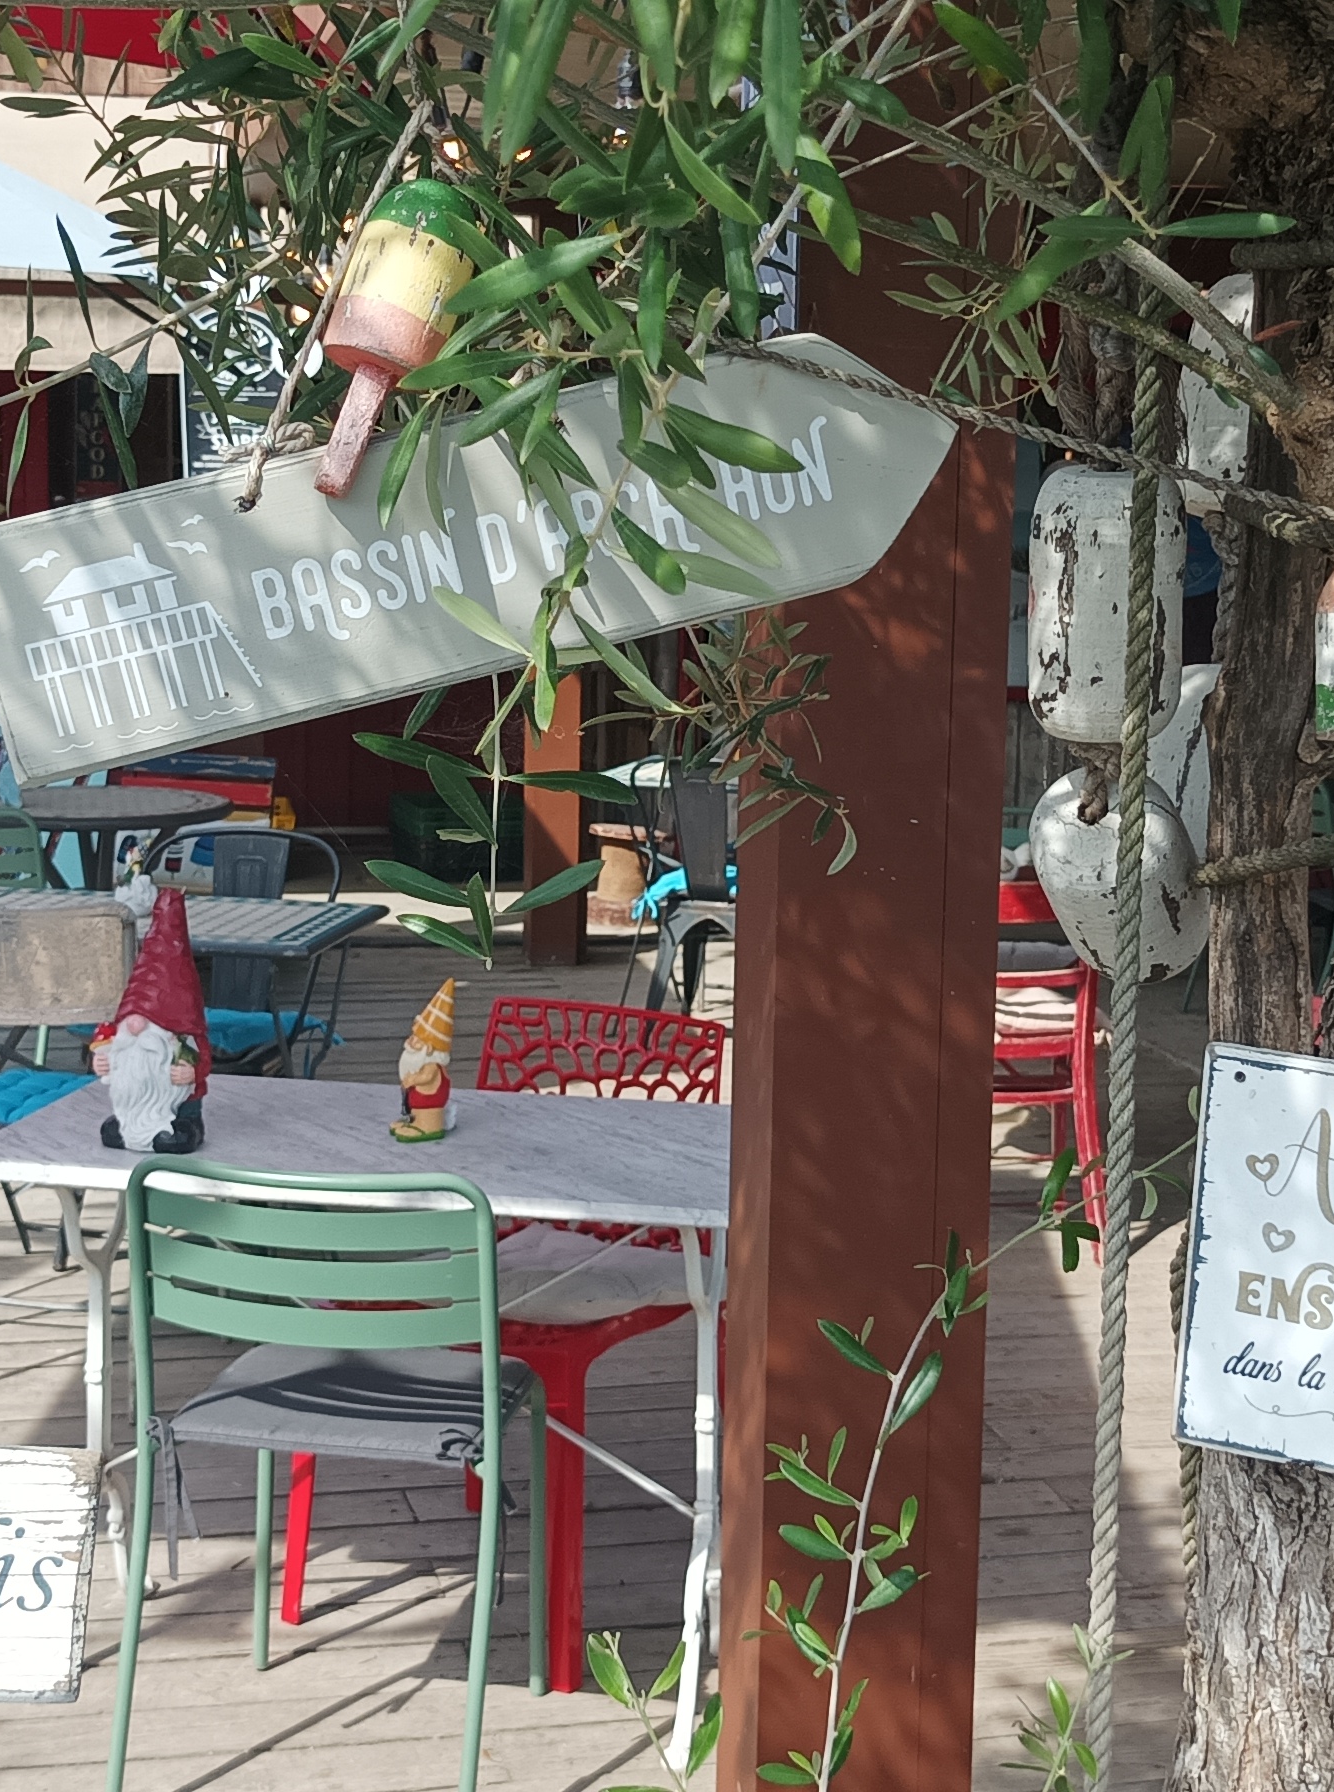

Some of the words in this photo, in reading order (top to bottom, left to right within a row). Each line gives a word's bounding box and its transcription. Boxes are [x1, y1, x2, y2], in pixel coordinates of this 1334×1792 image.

[251, 508, 464, 641] BASSIN
[1223, 1341, 1283, 1384] dans
[1297, 1353, 1326, 1390] la
